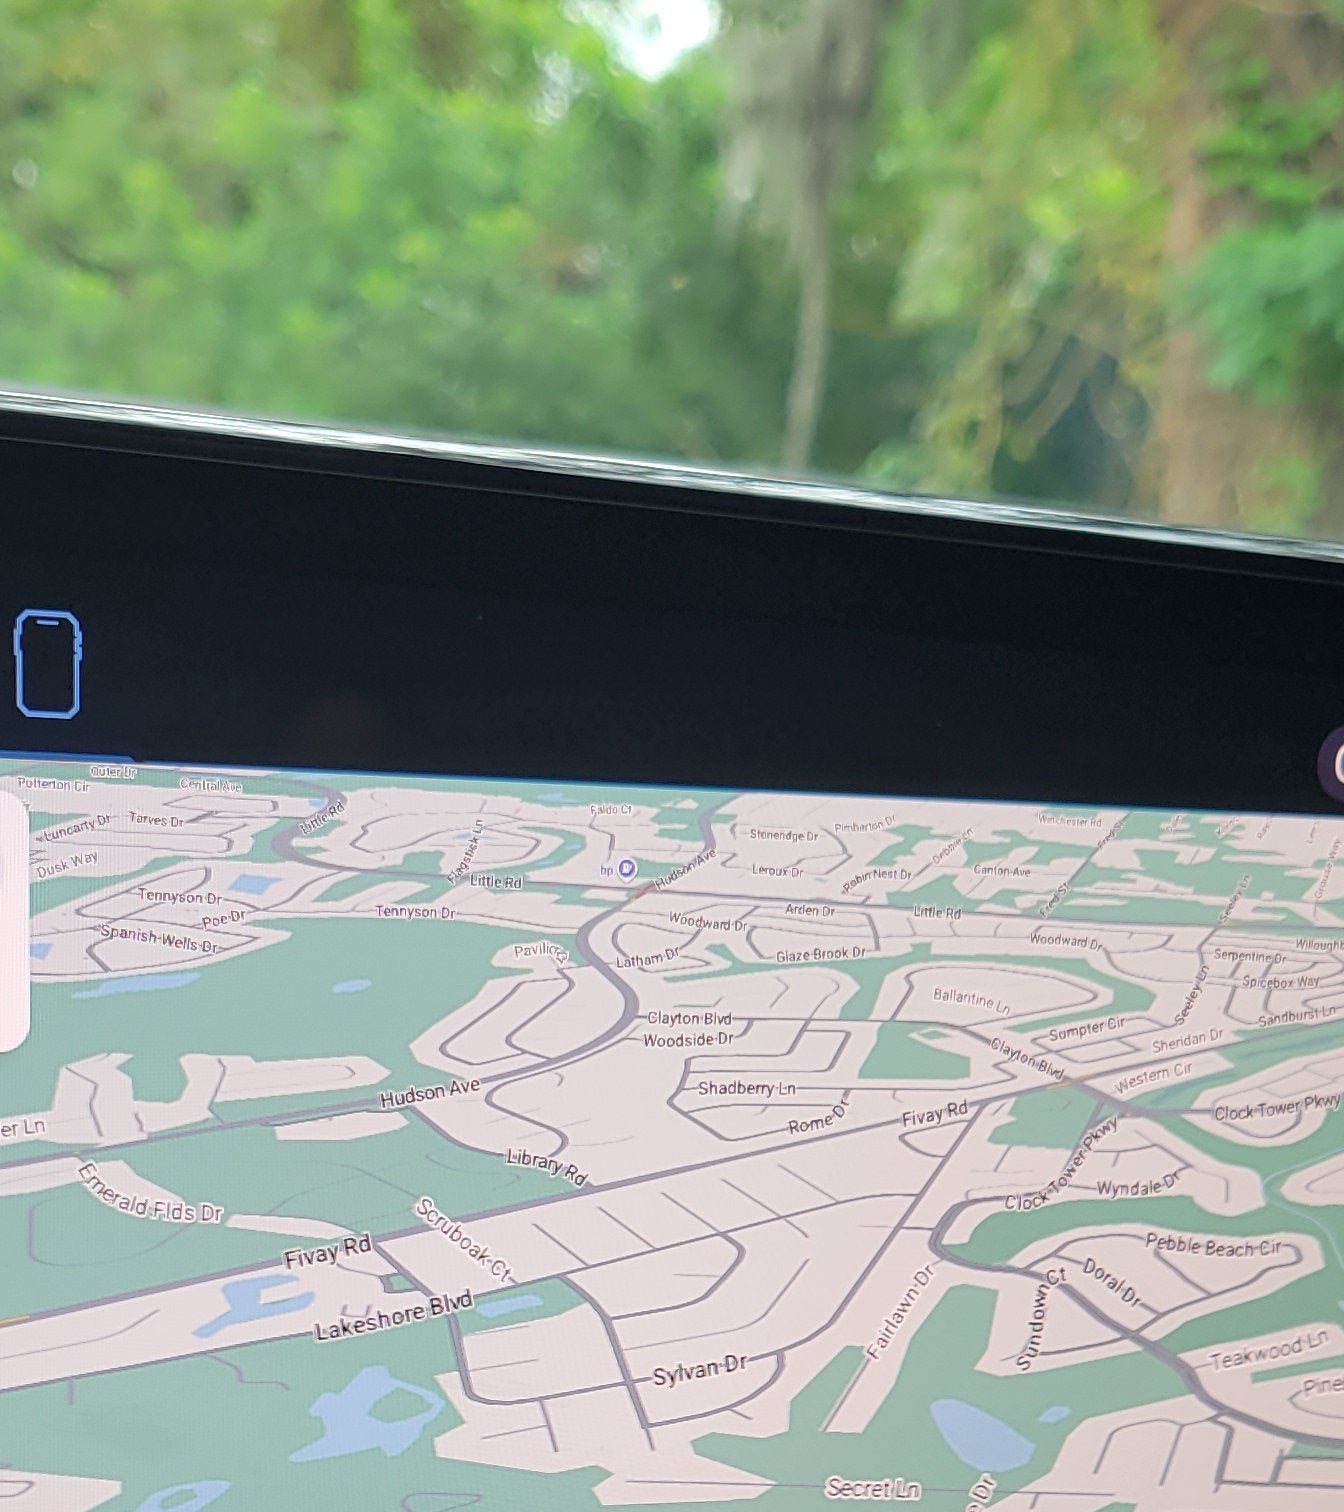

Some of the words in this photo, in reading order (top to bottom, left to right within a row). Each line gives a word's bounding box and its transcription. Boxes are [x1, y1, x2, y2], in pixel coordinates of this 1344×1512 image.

[129, 811, 167, 827] Tarves
[170, 817, 184, 827] Dr
[38, 859, 68, 879] Dusk
[71, 851, 98, 867] Way
[447, 836, 482, 885] Flagstick
[473, 820, 483, 835] Ln
[601, 865, 613, 877] bp
[752, 865, 787, 878] Leroux
[789, 867, 803, 877] Dr
[376, 906, 437, 919] Tennyson
[441, 908, 455, 919] Dr
[1030, 934, 1086, 949] Woodward
[1090, 938, 1102, 952] Dr
[1214, 950, 1269, 962] Serpentine
[1272, 953, 1286, 963] Dr
[647, 1012, 698, 1027] Clayton
[702, 1011, 732, 1025] Blvd
[644, 1034, 714, 1048] Woodside
[718, 1031, 734, 1044] Dr
[1153, 1032, 1207, 1053] Sheridan
[1210, 1028, 1223, 1042] Dr
[699, 1081, 775, 1097] Shadberry
[779, 1083, 796, 1095] Ln
[1116, 1067, 1170, 1094] Western
[1174, 1061, 1192, 1075] Cir
[380, 1085, 445, 1108] Hudson
[449, 1079, 480, 1097] Ave
[1215, 1105, 1254, 1120] Clock
[1259, 1103, 1300, 1117] Tower
[1303, 1094, 1341, 1111] Pkwy
[26, 1119, 45, 1135] Ln
[788, 1116, 833, 1134] Rome
[834, 1099, 849, 1118] Dr
[902, 1105, 944, 1127] Fivay
[947, 1101, 968, 1116] Rd
[507, 1149, 562, 1176] Library
[564, 1166, 587, 1186] Rd
[1005, 1192, 1048, 1211] Clock
[1049, 1150, 1085, 1193] Tower
[1084, 1117, 1119, 1151] Pkwy
[1097, 1175, 1159, 1196] Wyndale
[1162, 1168, 1180, 1187] Dr
[285, 1244, 338, 1270] Fivay
[344, 1234, 372, 1256] Rd
[1145, 1233, 1201, 1254] Pebble
[1205, 1242, 1254, 1256] Beach
[1260, 1240, 1281, 1255] Cir
[1082, 1258, 1122, 1296] Doral
[1121, 1289, 1141, 1307] Dr
[315, 1306, 425, 1341] Lakeshore
[429, 1289, 473, 1315] Blvd
[867, 1285, 920, 1360] Fairlawn
[914, 1263, 934, 1287] Dr
[1017, 1285, 1049, 1371] Sundown
[1047, 1268, 1066, 1284] Ct
[1209, 1338, 1302, 1370] Teakwood
[1307, 1330, 1328, 1347] Ln
[654, 1362, 718, 1388] Sylvan
[725, 1354, 747, 1372] Dr
[826, 1479, 891, 1499] Secret
[896, 1480, 920, 1498] Ln
[972, 1475, 995, 1503] Dr
